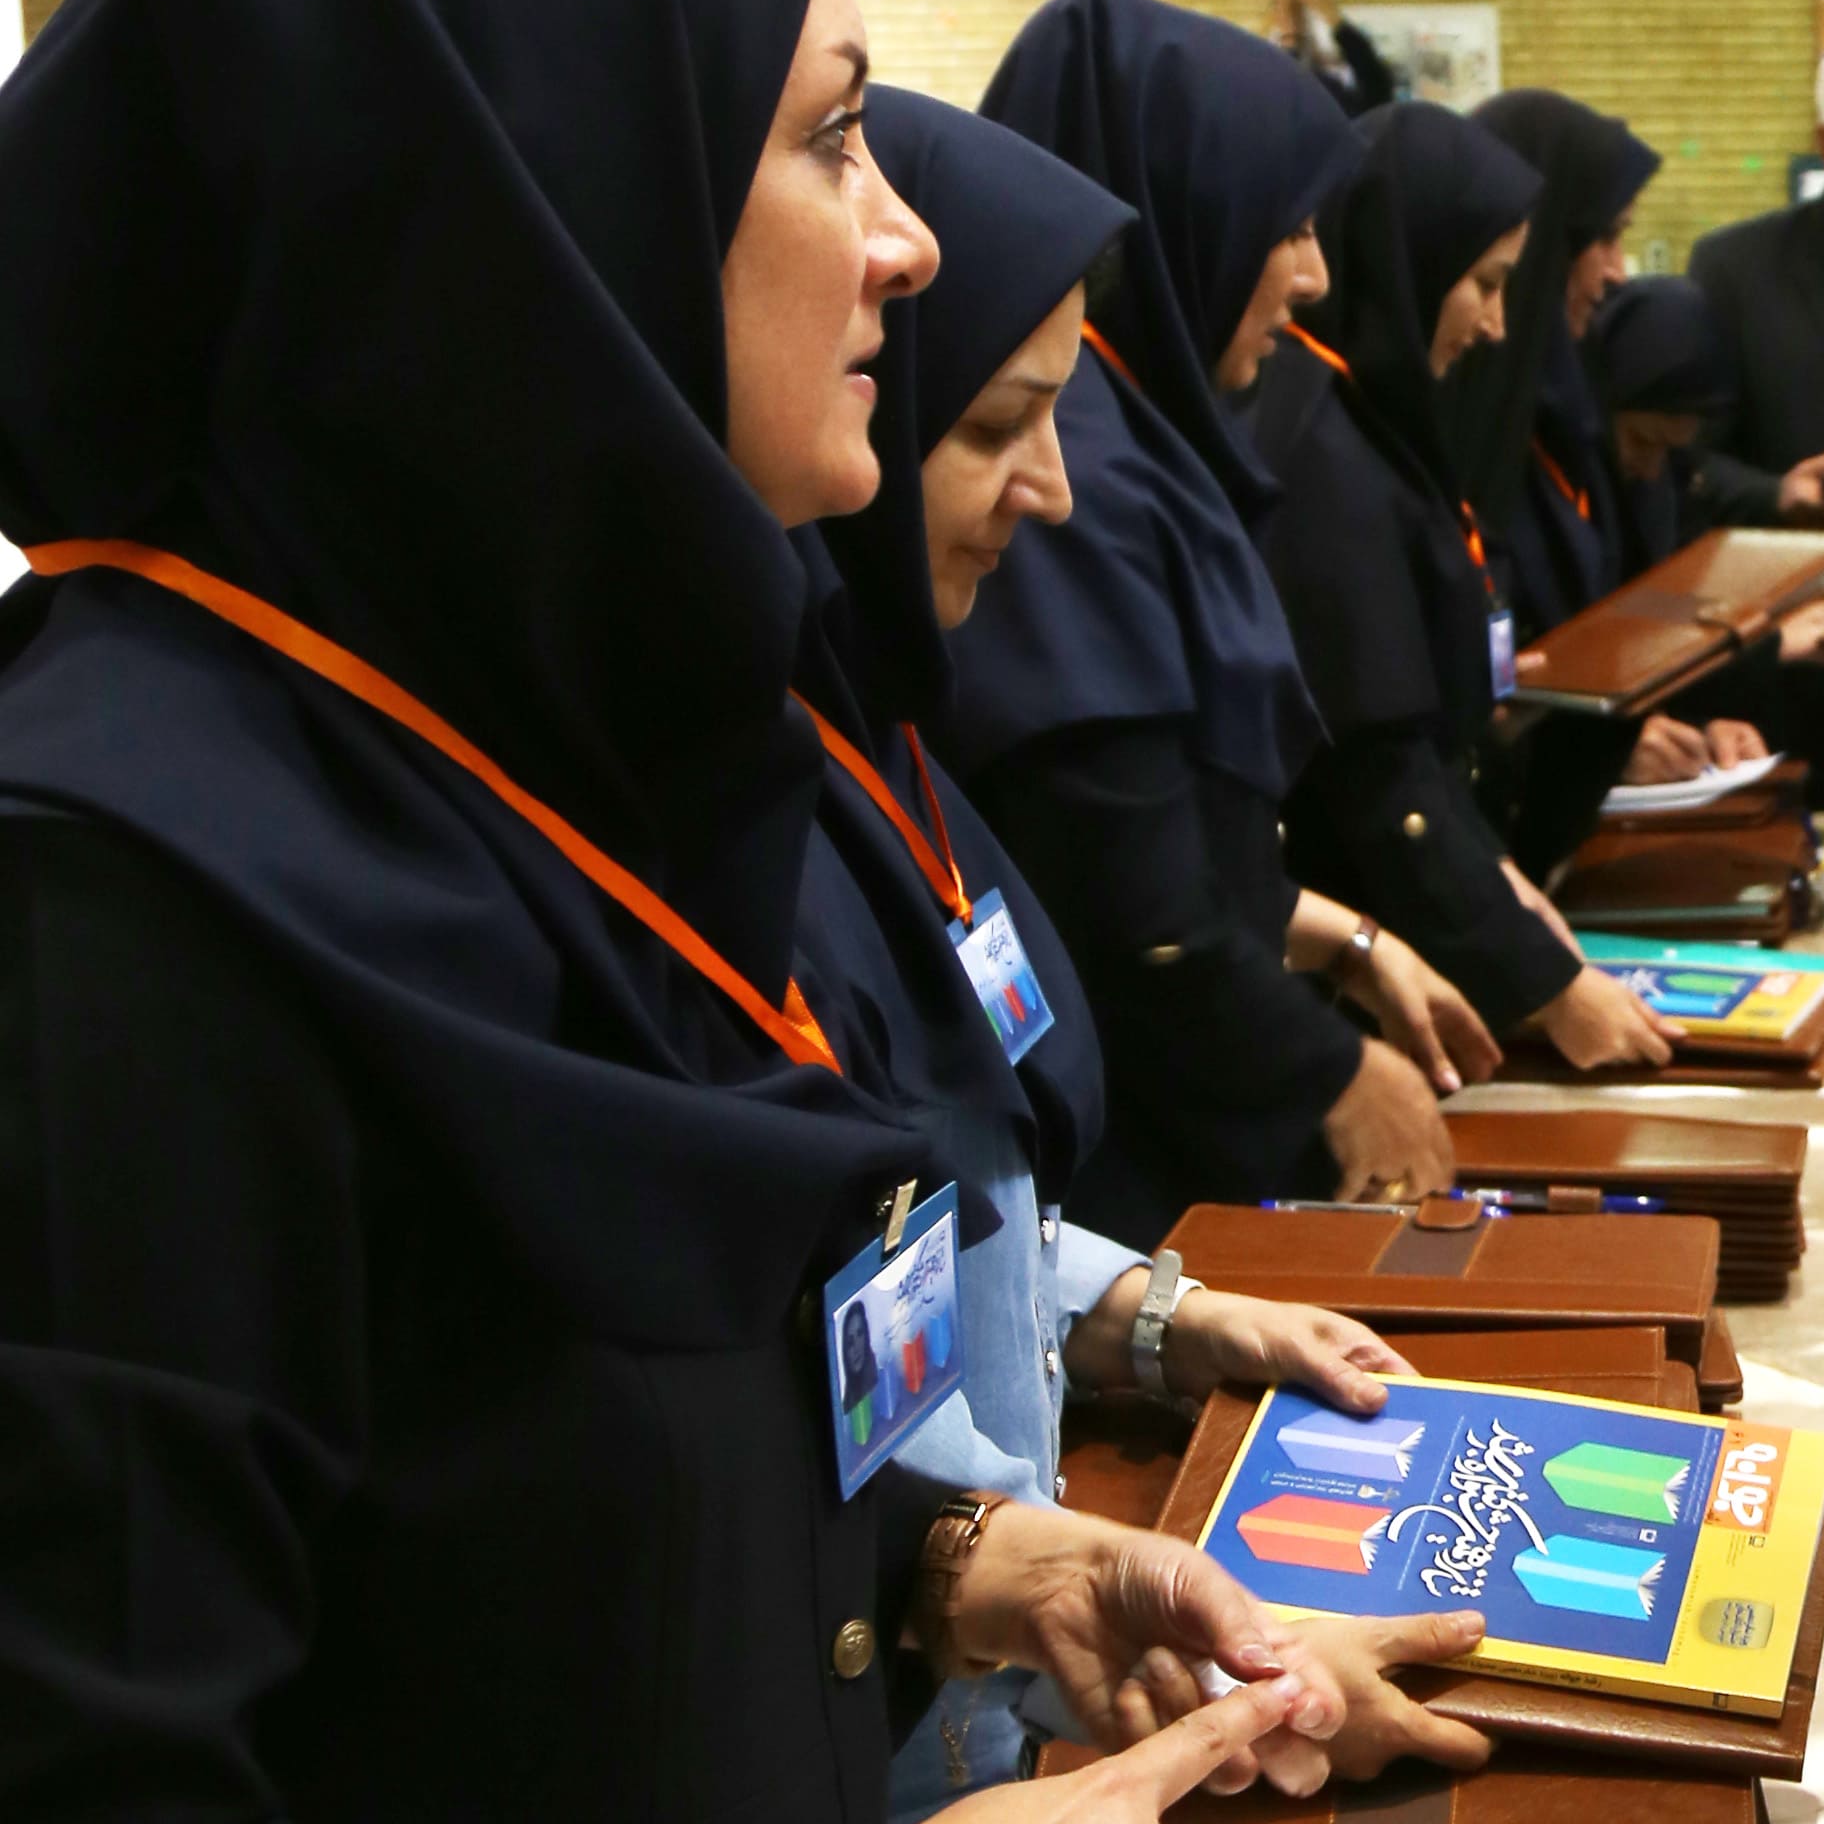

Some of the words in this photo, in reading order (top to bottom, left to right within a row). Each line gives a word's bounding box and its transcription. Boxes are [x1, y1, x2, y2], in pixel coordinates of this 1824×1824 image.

[1386, 1504, 1496, 1597] شانزدهمین
[1442, 1454, 1512, 1545] جشنواره
[1713, 1442, 1778, 1526] جوانه
